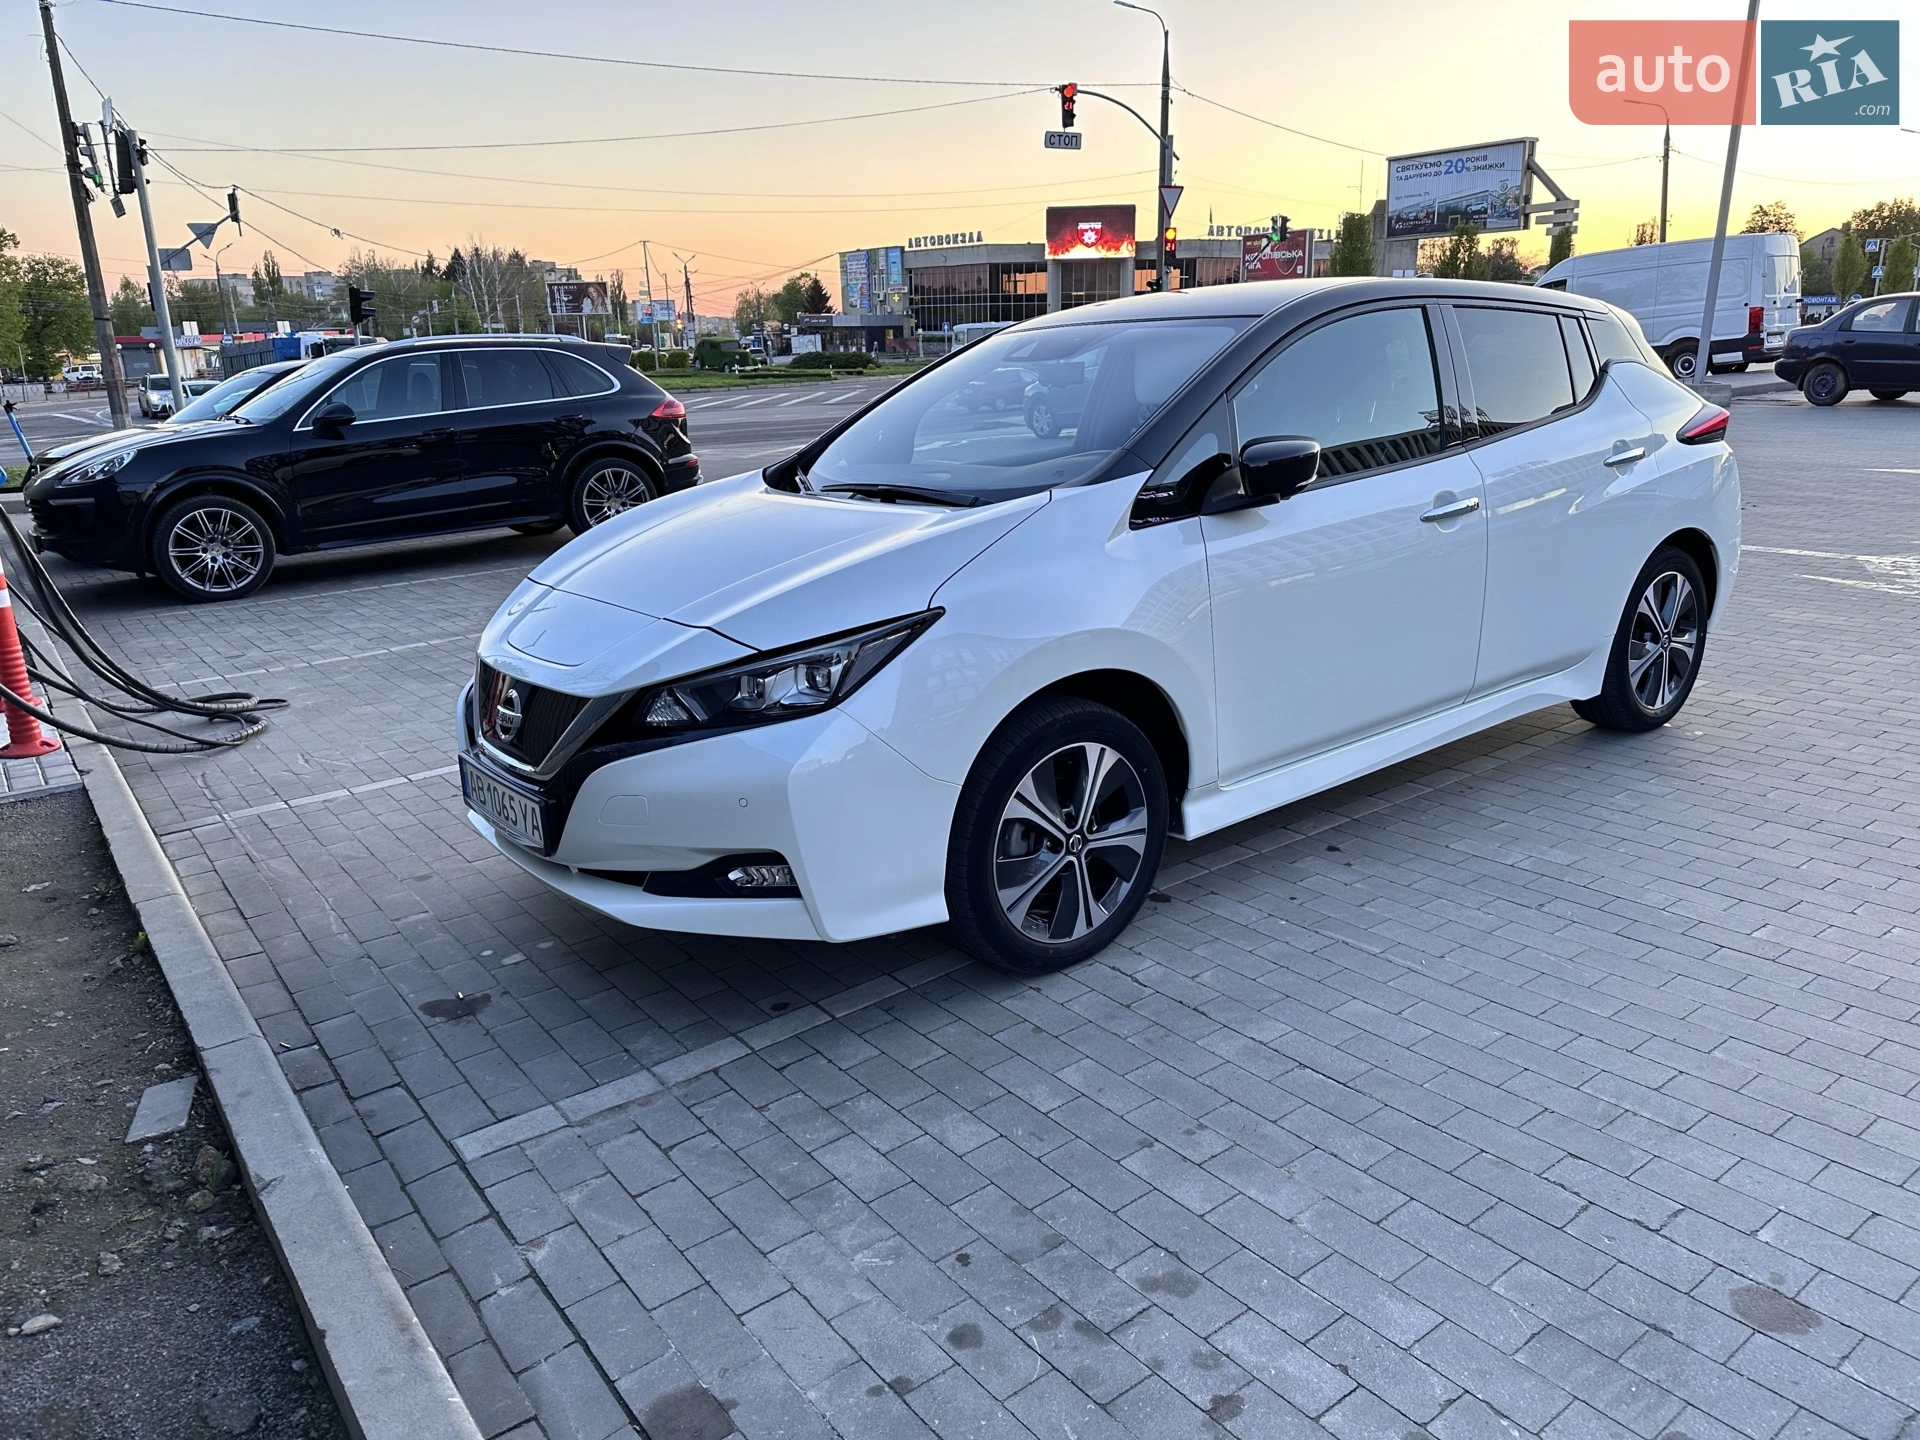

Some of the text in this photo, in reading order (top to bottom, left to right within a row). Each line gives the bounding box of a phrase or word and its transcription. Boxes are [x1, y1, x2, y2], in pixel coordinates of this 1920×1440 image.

[1049, 134, 1077, 146] СТОП
[1396, 155, 1488, 175] СВЯТКУЄМО 20 РОКІВ
[1403, 172, 1433, 181] ДАРУЄМО
[1433, 170, 1443, 178] ДО
[1471, 161, 1505, 172] ЗНИЖКИ
[908, 231, 983, 248] АВТОВОКЗАЛ
[1166, 243, 1175, 251] 21
